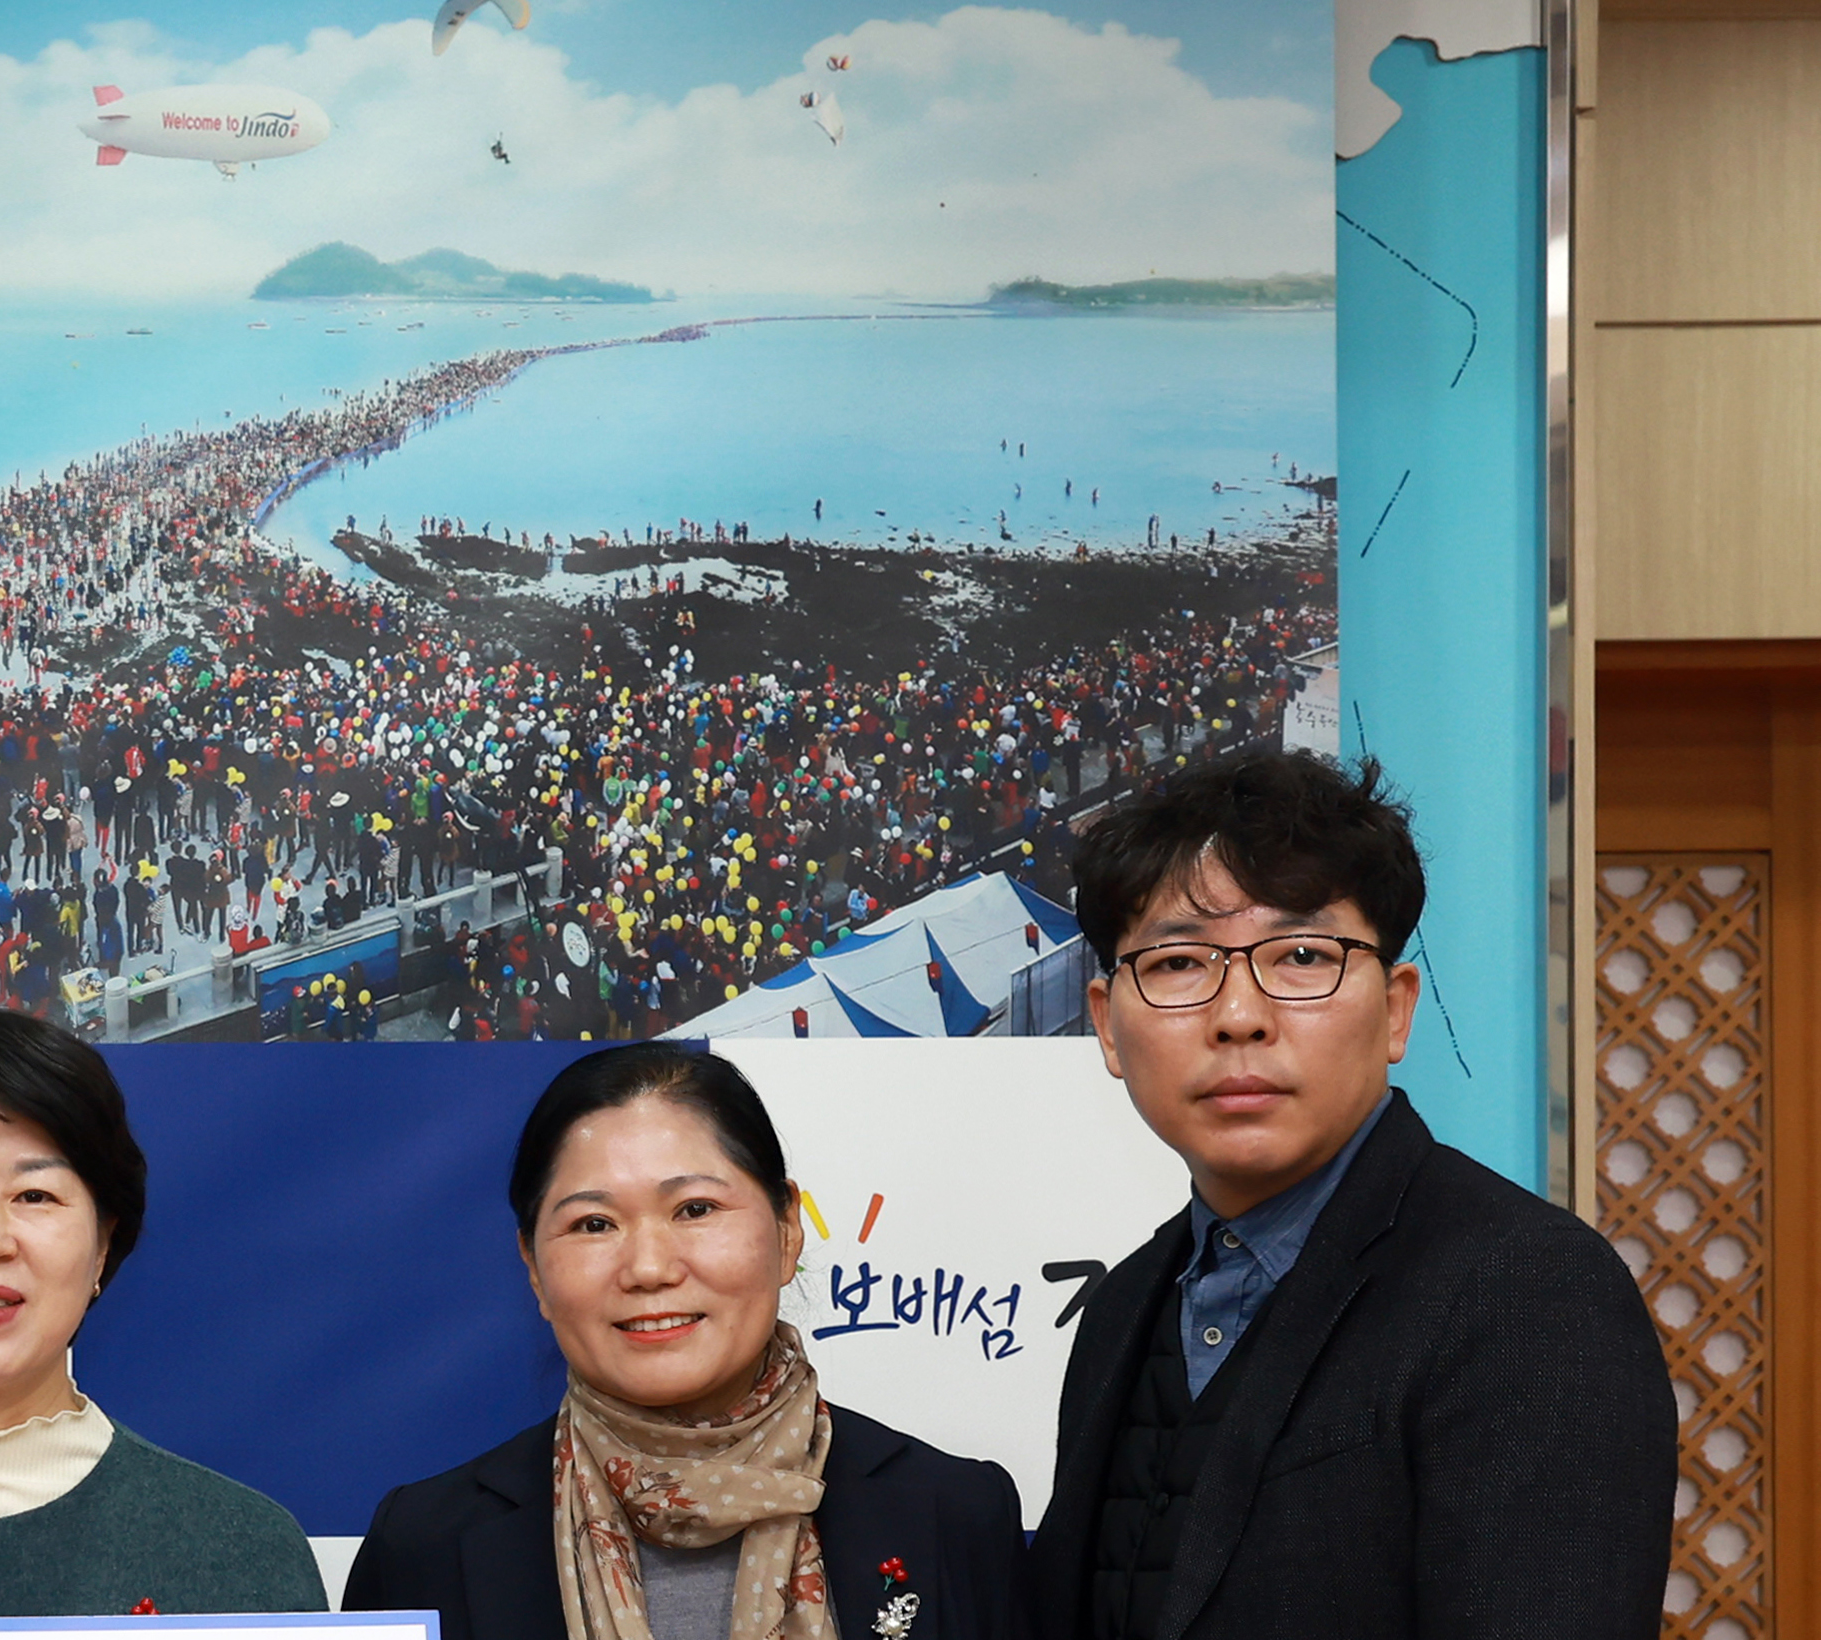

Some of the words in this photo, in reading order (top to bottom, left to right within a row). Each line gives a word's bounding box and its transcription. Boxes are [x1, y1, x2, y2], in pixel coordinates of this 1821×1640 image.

[162, 111, 221, 131] Welcome
[226, 114, 239, 131] to
[236, 115, 289, 138] Jindo
[812, 1262, 1023, 1361] 보배섬
